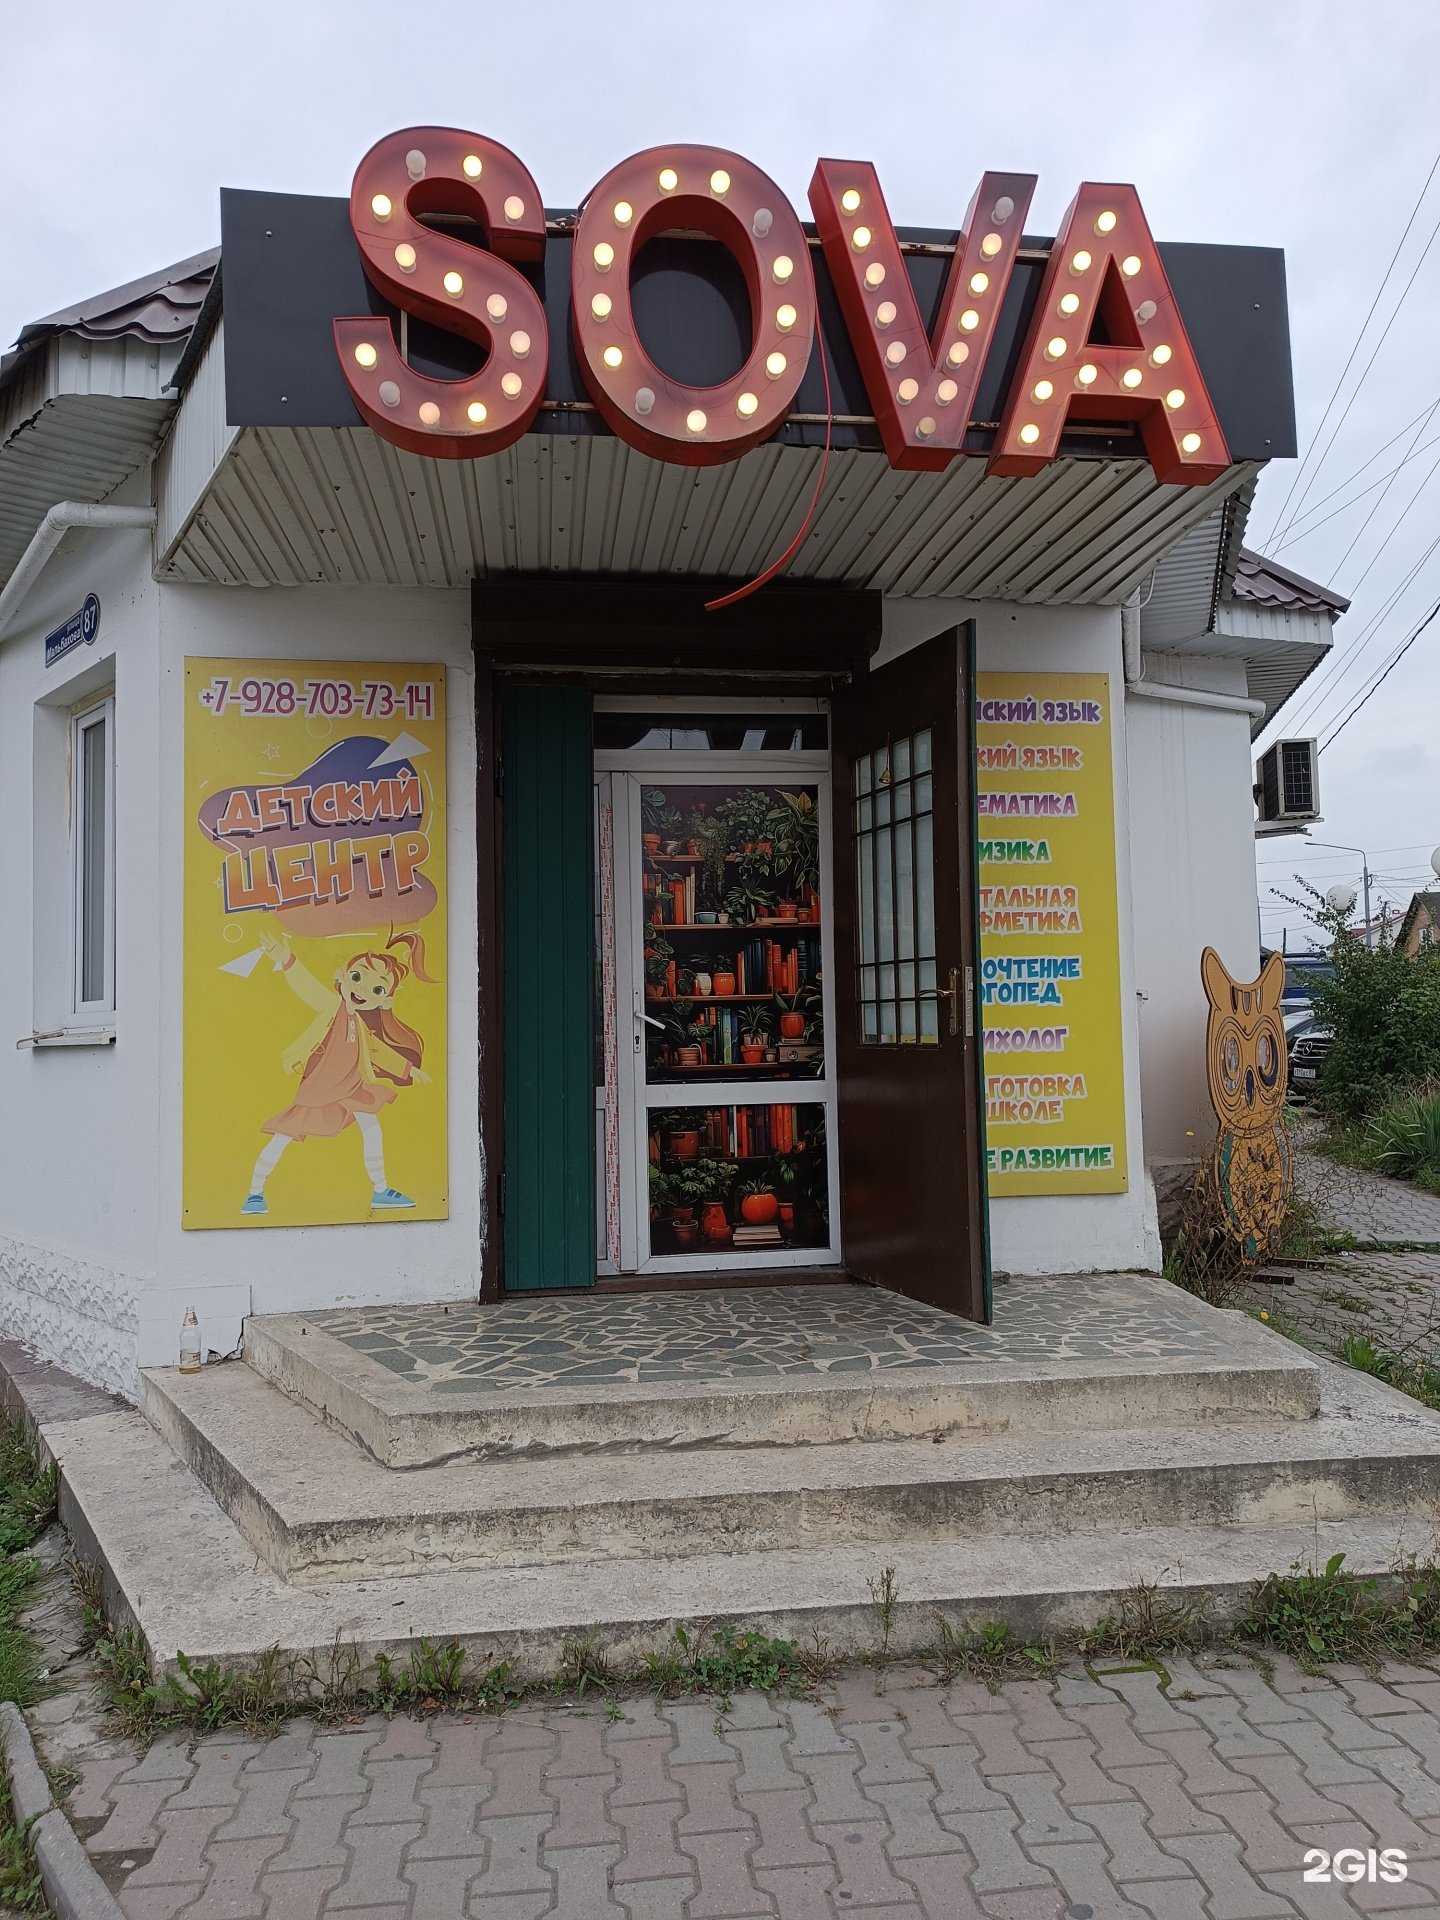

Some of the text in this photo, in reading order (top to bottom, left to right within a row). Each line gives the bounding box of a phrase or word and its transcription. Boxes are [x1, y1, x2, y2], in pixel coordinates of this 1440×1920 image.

[332, 126, 1232, 485] SOVA
[84, 605, 96, 633] 87
[202, 680, 432, 717] +7-928-703-73-14
[1042, 701, 1101, 722] ЯЗЫК
[1022, 747, 1081, 769] ЯЗЫК
[216, 768, 423, 834] ДЕТСКИЙ
[225, 831, 431, 911] ЦЕНТР
[1001, 1146, 1112, 1170] РАЗВИТИЕ
